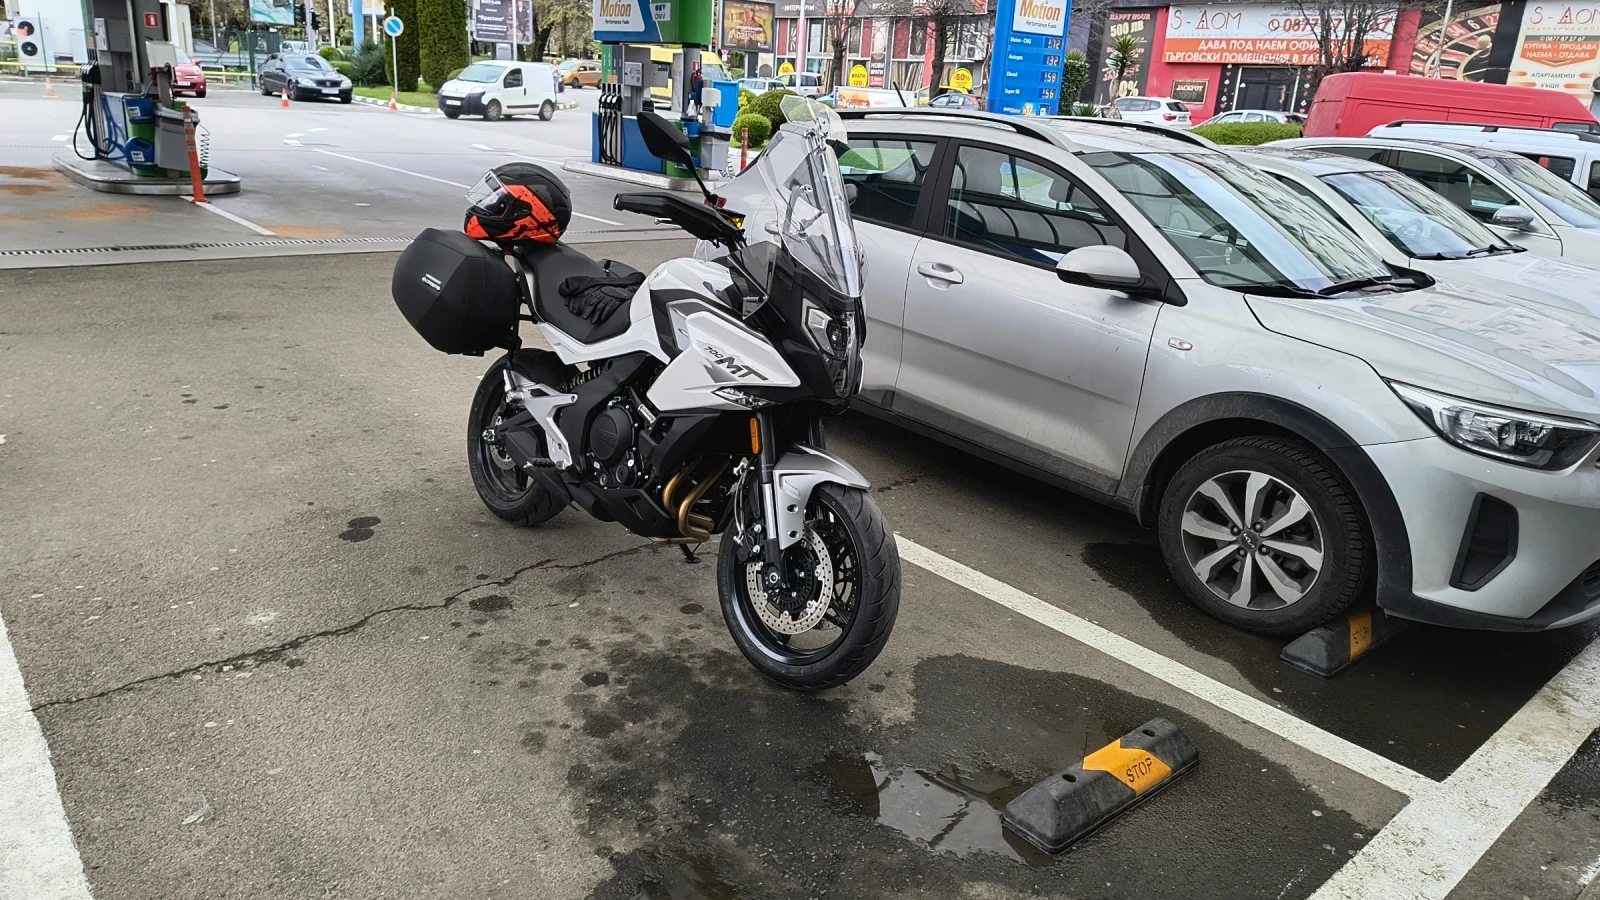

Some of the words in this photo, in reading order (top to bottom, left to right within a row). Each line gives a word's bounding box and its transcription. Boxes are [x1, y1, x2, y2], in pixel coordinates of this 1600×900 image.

[600, 0, 631, 17] Motion
[1019, 0, 1061, 21] Motion
[1110, 22, 1129, 38] 500
[1283, 18, 1320, 32] 0877
[1468, 20, 1480, 30] 6
[1198, 40, 1226, 50] ДАВА
[1230, 40, 1253, 50] ПОД
[1256, 40, 1287, 50] НАЕМ
[1166, 52, 1220, 61] ТЪРГОВСКИ
[1222, 53, 1290, 64] ПОМЕЩЕНИЯ
[1292, 54, 1299, 63] В
[714, 356, 769, 381] MT
[1126, 757, 1152, 782] STOP
